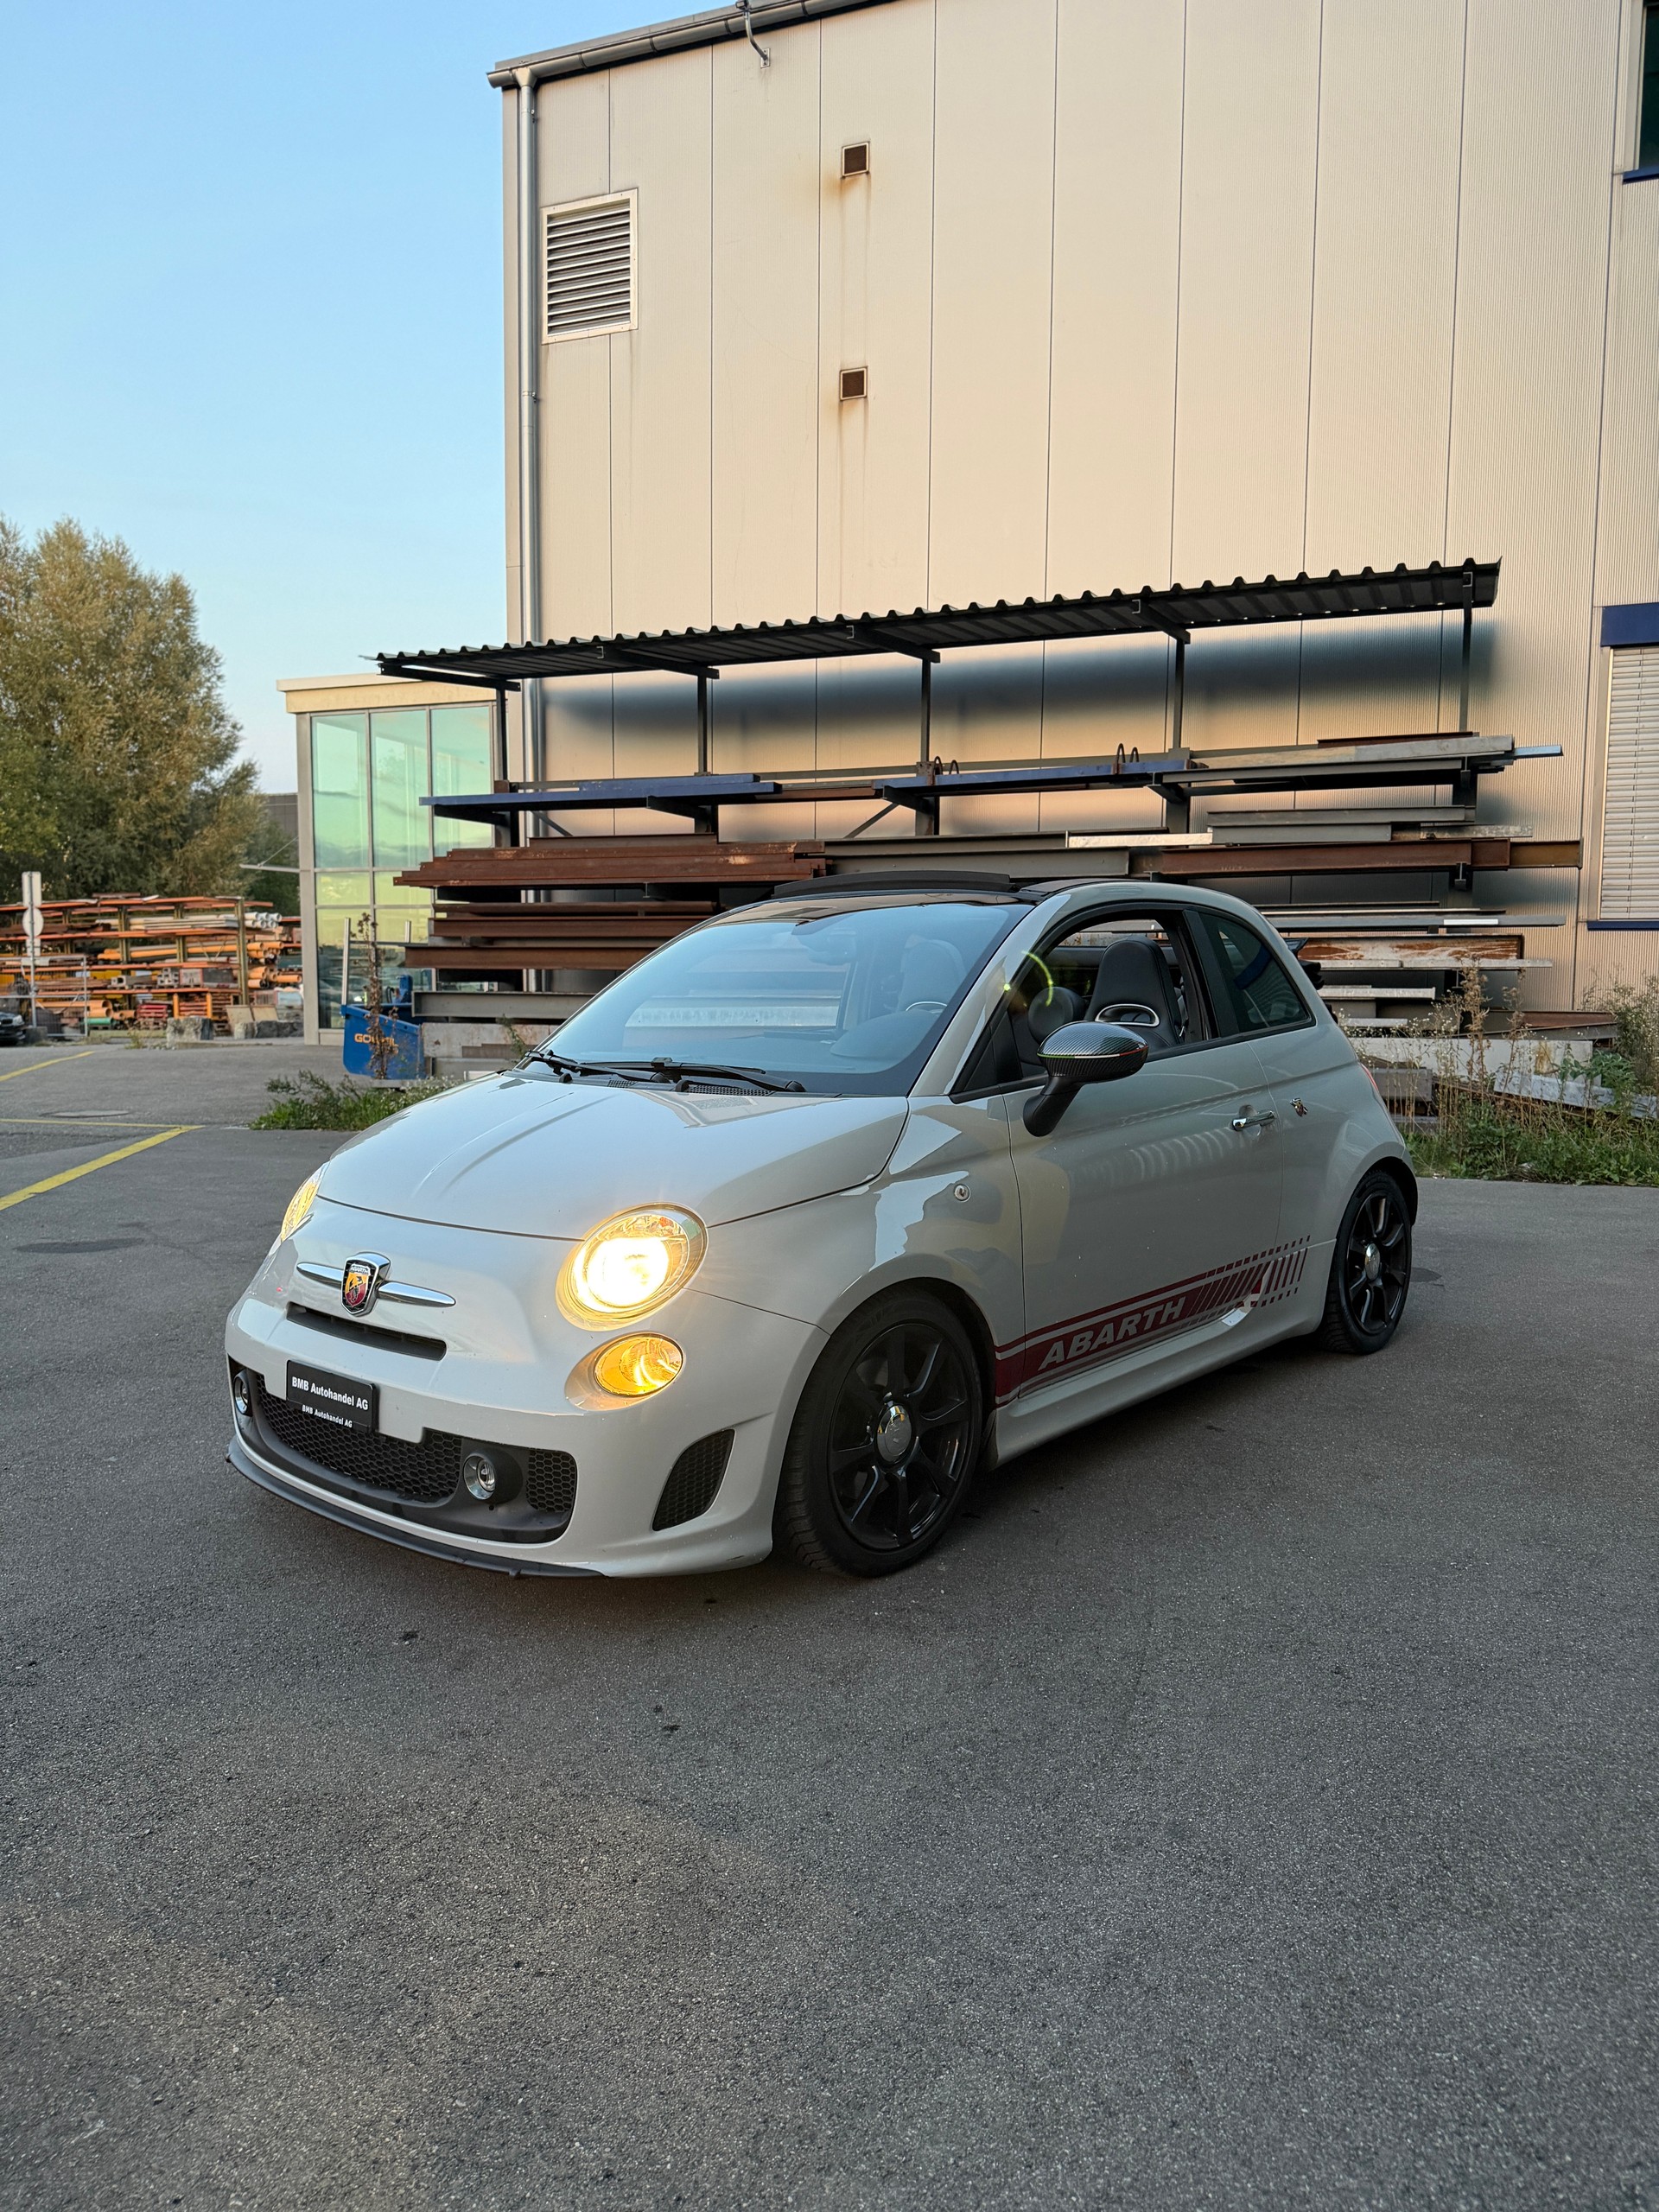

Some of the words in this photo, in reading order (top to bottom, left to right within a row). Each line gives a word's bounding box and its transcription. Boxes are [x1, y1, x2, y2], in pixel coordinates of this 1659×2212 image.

[1038, 1297, 1187, 1370] ABARTH
[291, 1376, 309, 1391] BMB
[310, 1382, 354, 1406] Autohandel
[356, 1397, 369, 1411] AG
[302, 1404, 314, 1414] BMB
[314, 1408, 344, 1425] Autohandel
[344, 1420, 353, 1428] AG
